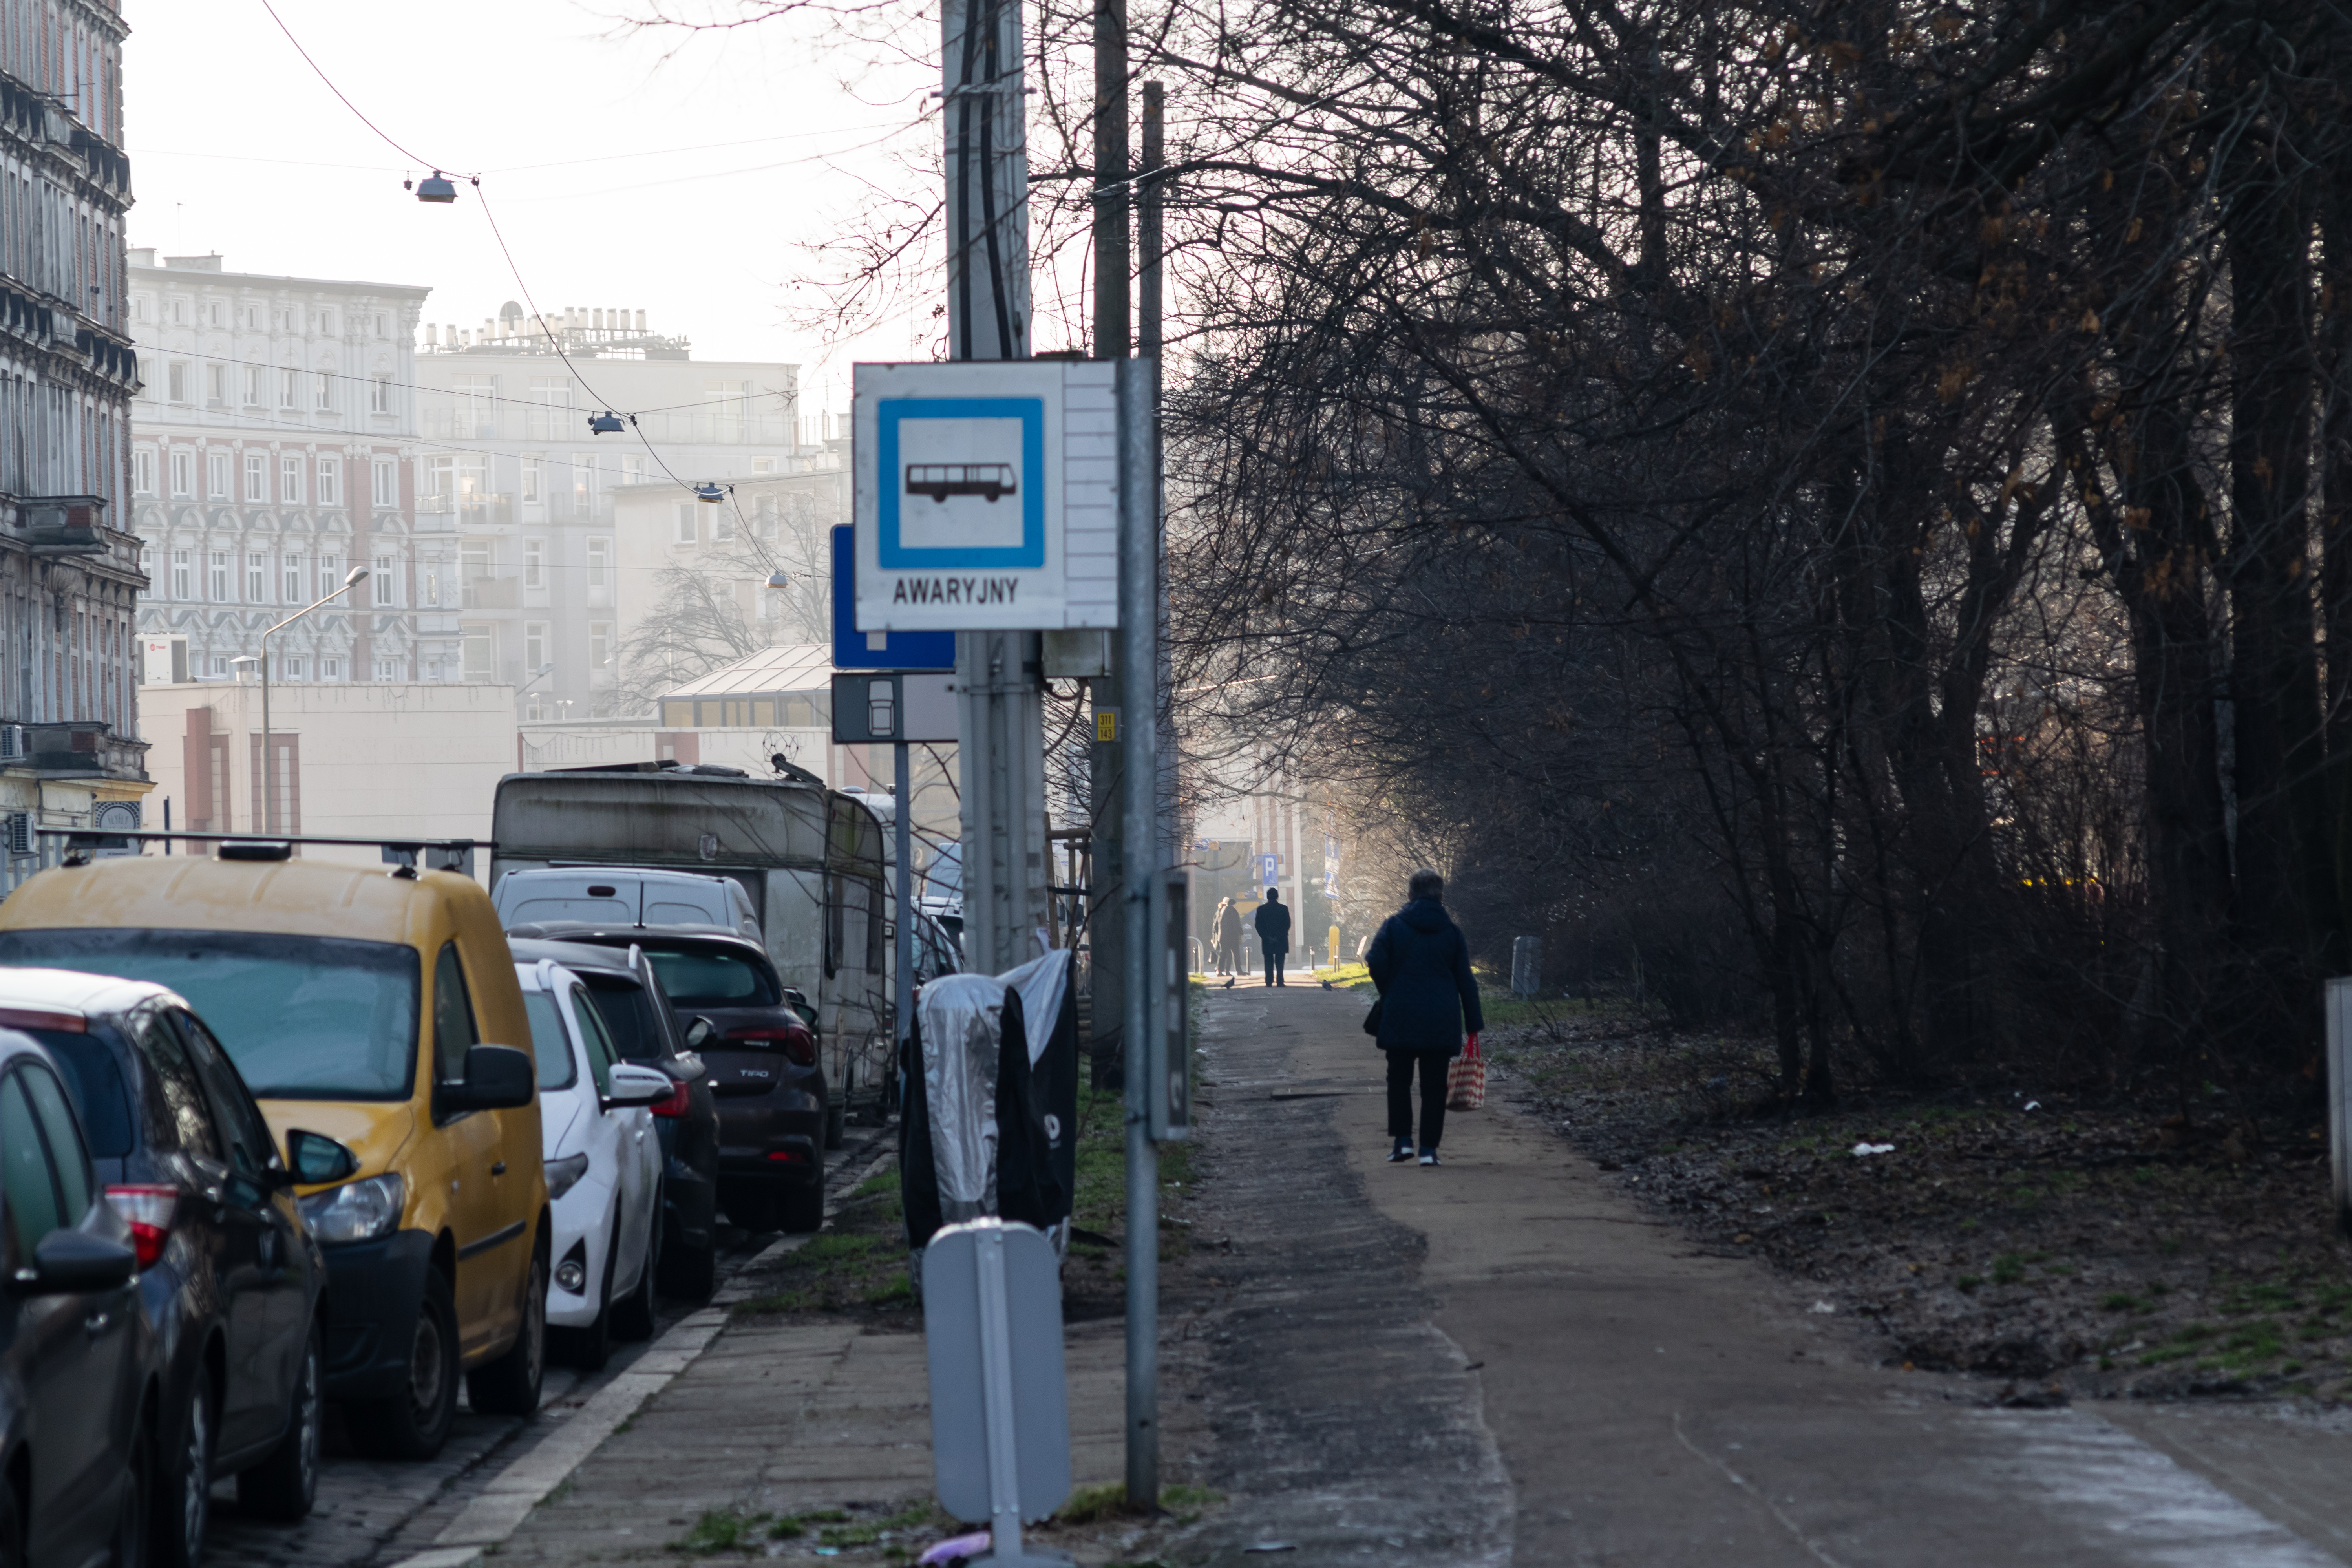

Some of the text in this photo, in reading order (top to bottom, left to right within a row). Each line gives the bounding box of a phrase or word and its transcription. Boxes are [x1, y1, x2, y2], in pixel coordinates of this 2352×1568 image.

[893, 577, 1018, 604] AWARYJNY
[1100, 715, 1111, 725] 311
[1100, 729, 1112, 739] 143
[1265, 857, 1274, 877] P
[740, 1069, 769, 1078] TIPO
